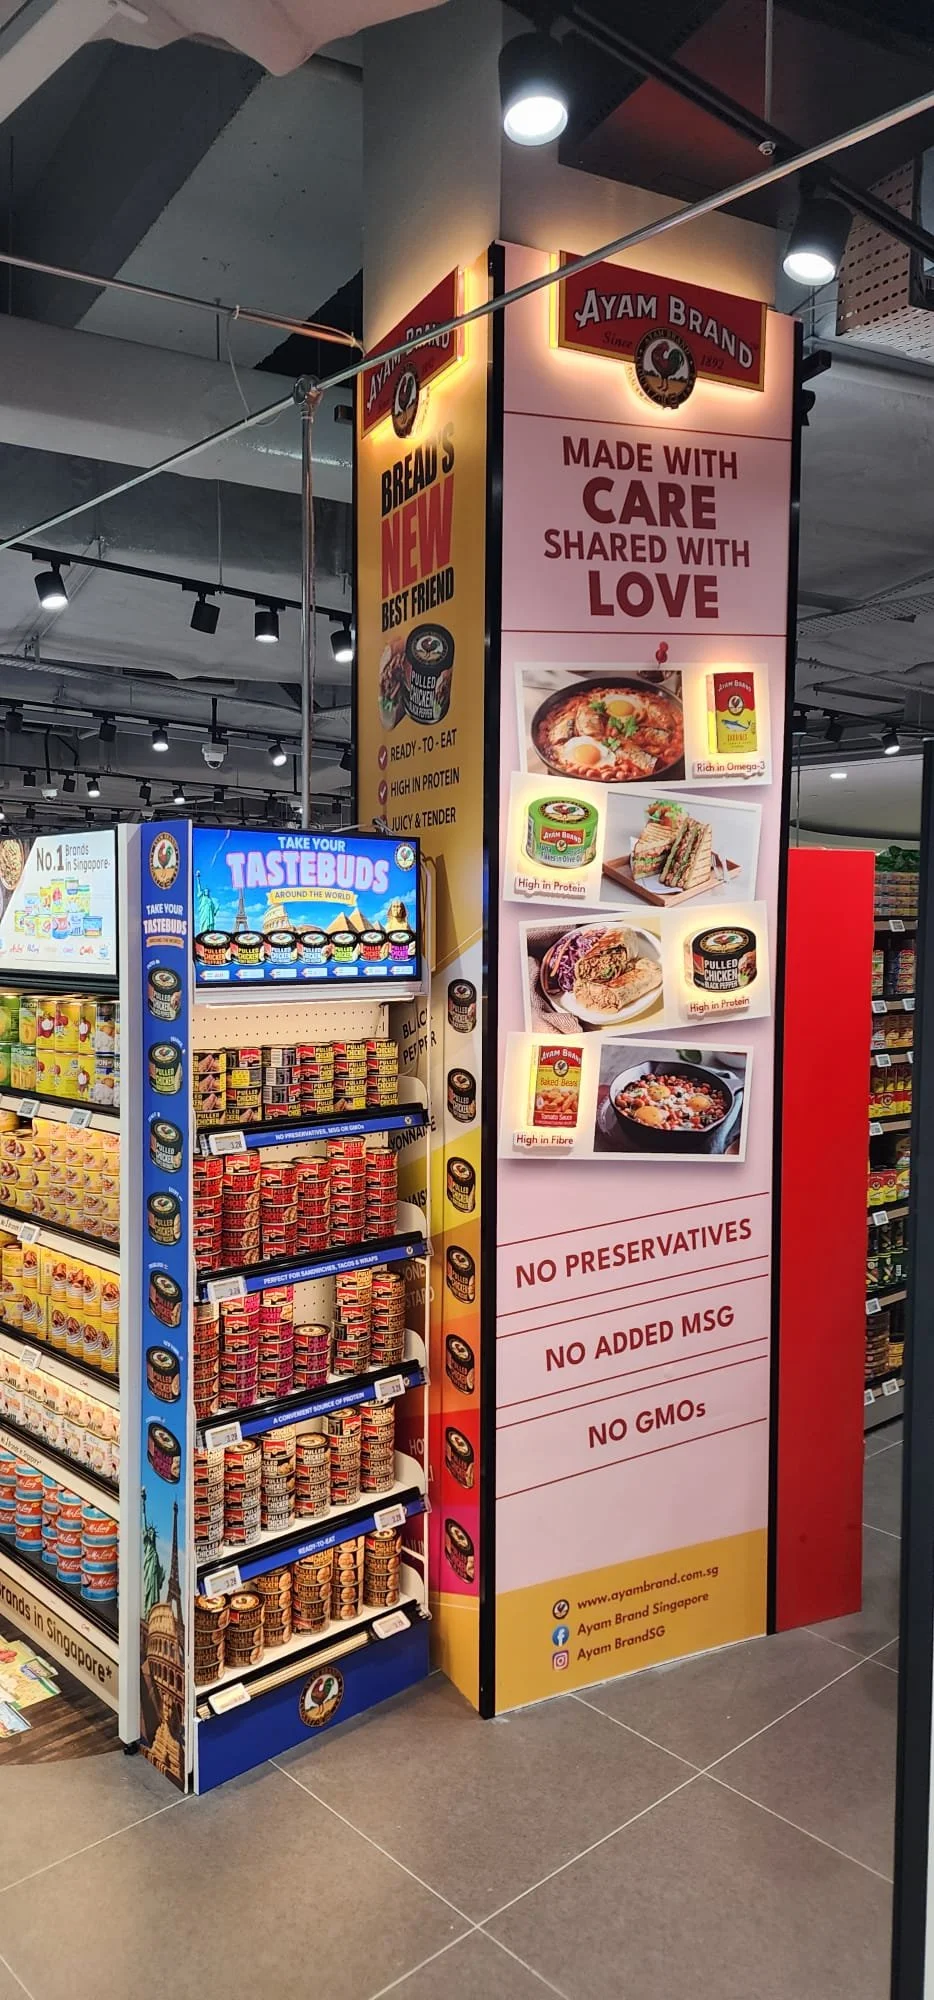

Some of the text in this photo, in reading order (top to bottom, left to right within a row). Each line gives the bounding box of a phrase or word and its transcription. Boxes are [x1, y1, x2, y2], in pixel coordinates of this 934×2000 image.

[574, 288, 754, 369] AYAM BRAND
[602, 331, 633, 348] Since
[381, 422, 455, 516] BREAD'S
[562, 436, 737, 480] MADE WITH
[582, 476, 717, 530] CARE
[381, 475, 454, 599] NEW
[543, 528, 750, 567] SHARED WITH
[382, 566, 454, 632] BEST FRIEND
[588, 570, 719, 619] LOVE
[411, 670, 436, 689] PULLED
[410, 684, 435, 708] CHICKEN
[390, 739, 417, 762] READY
[422, 734, 434, 752] TO
[440, 728, 457, 749] EAT
[696, 760, 766, 774] Rich in Omega-3
[390, 767, 460, 798] HIGH IN PROTEIN
[391, 807, 456, 832] JUICY & TENDER
[36, 844, 89, 872] No.1 Brands
[277, 836, 346, 853] TAKE YOUR
[65, 859, 72, 872] in
[226, 851, 390, 894] TASTEBUDS
[274, 890, 351, 901] AROUND THE WORLD
[518, 878, 586, 893] High in Protein
[146, 903, 183, 916] TAKE YOUR
[143, 919, 187, 935] TASTEBUDS
[704, 958, 738, 969] PULLED
[704, 968, 738, 981] CHICKEN
[720, 980, 738, 989] PEPPER
[690, 996, 750, 1013] High in Protein
[541, 1050, 560, 1062] AYAM
[516, 1134, 574, 1146] High in Fibre
[515, 1218, 752, 1288] NO PRESERVATIVES
[263, 1274, 288, 1285] PERFECT
[289, 1272, 301, 1280] FOR
[337, 1260, 355, 1269] TACOS
[360, 1256, 379, 1265] WRAPS
[545, 1305, 735, 1372] NO ADDED MSG
[278, 1406, 313, 1422] CONVENIENT
[313, 1400, 334, 1412] SOURCE
[343, 1392, 365, 1403] PROTEIN
[588, 1399, 707, 1449] NO GMOs
[298, 1536, 336, 1555] READY-TO-EAT
[577, 1565, 719, 1610] www.ayambrand.com.sg
[33, 1605, 43, 1632] in
[577, 1592, 709, 1637] Ayam Brand Singapore
[577, 1625, 666, 1662] Ayam BrandSG
